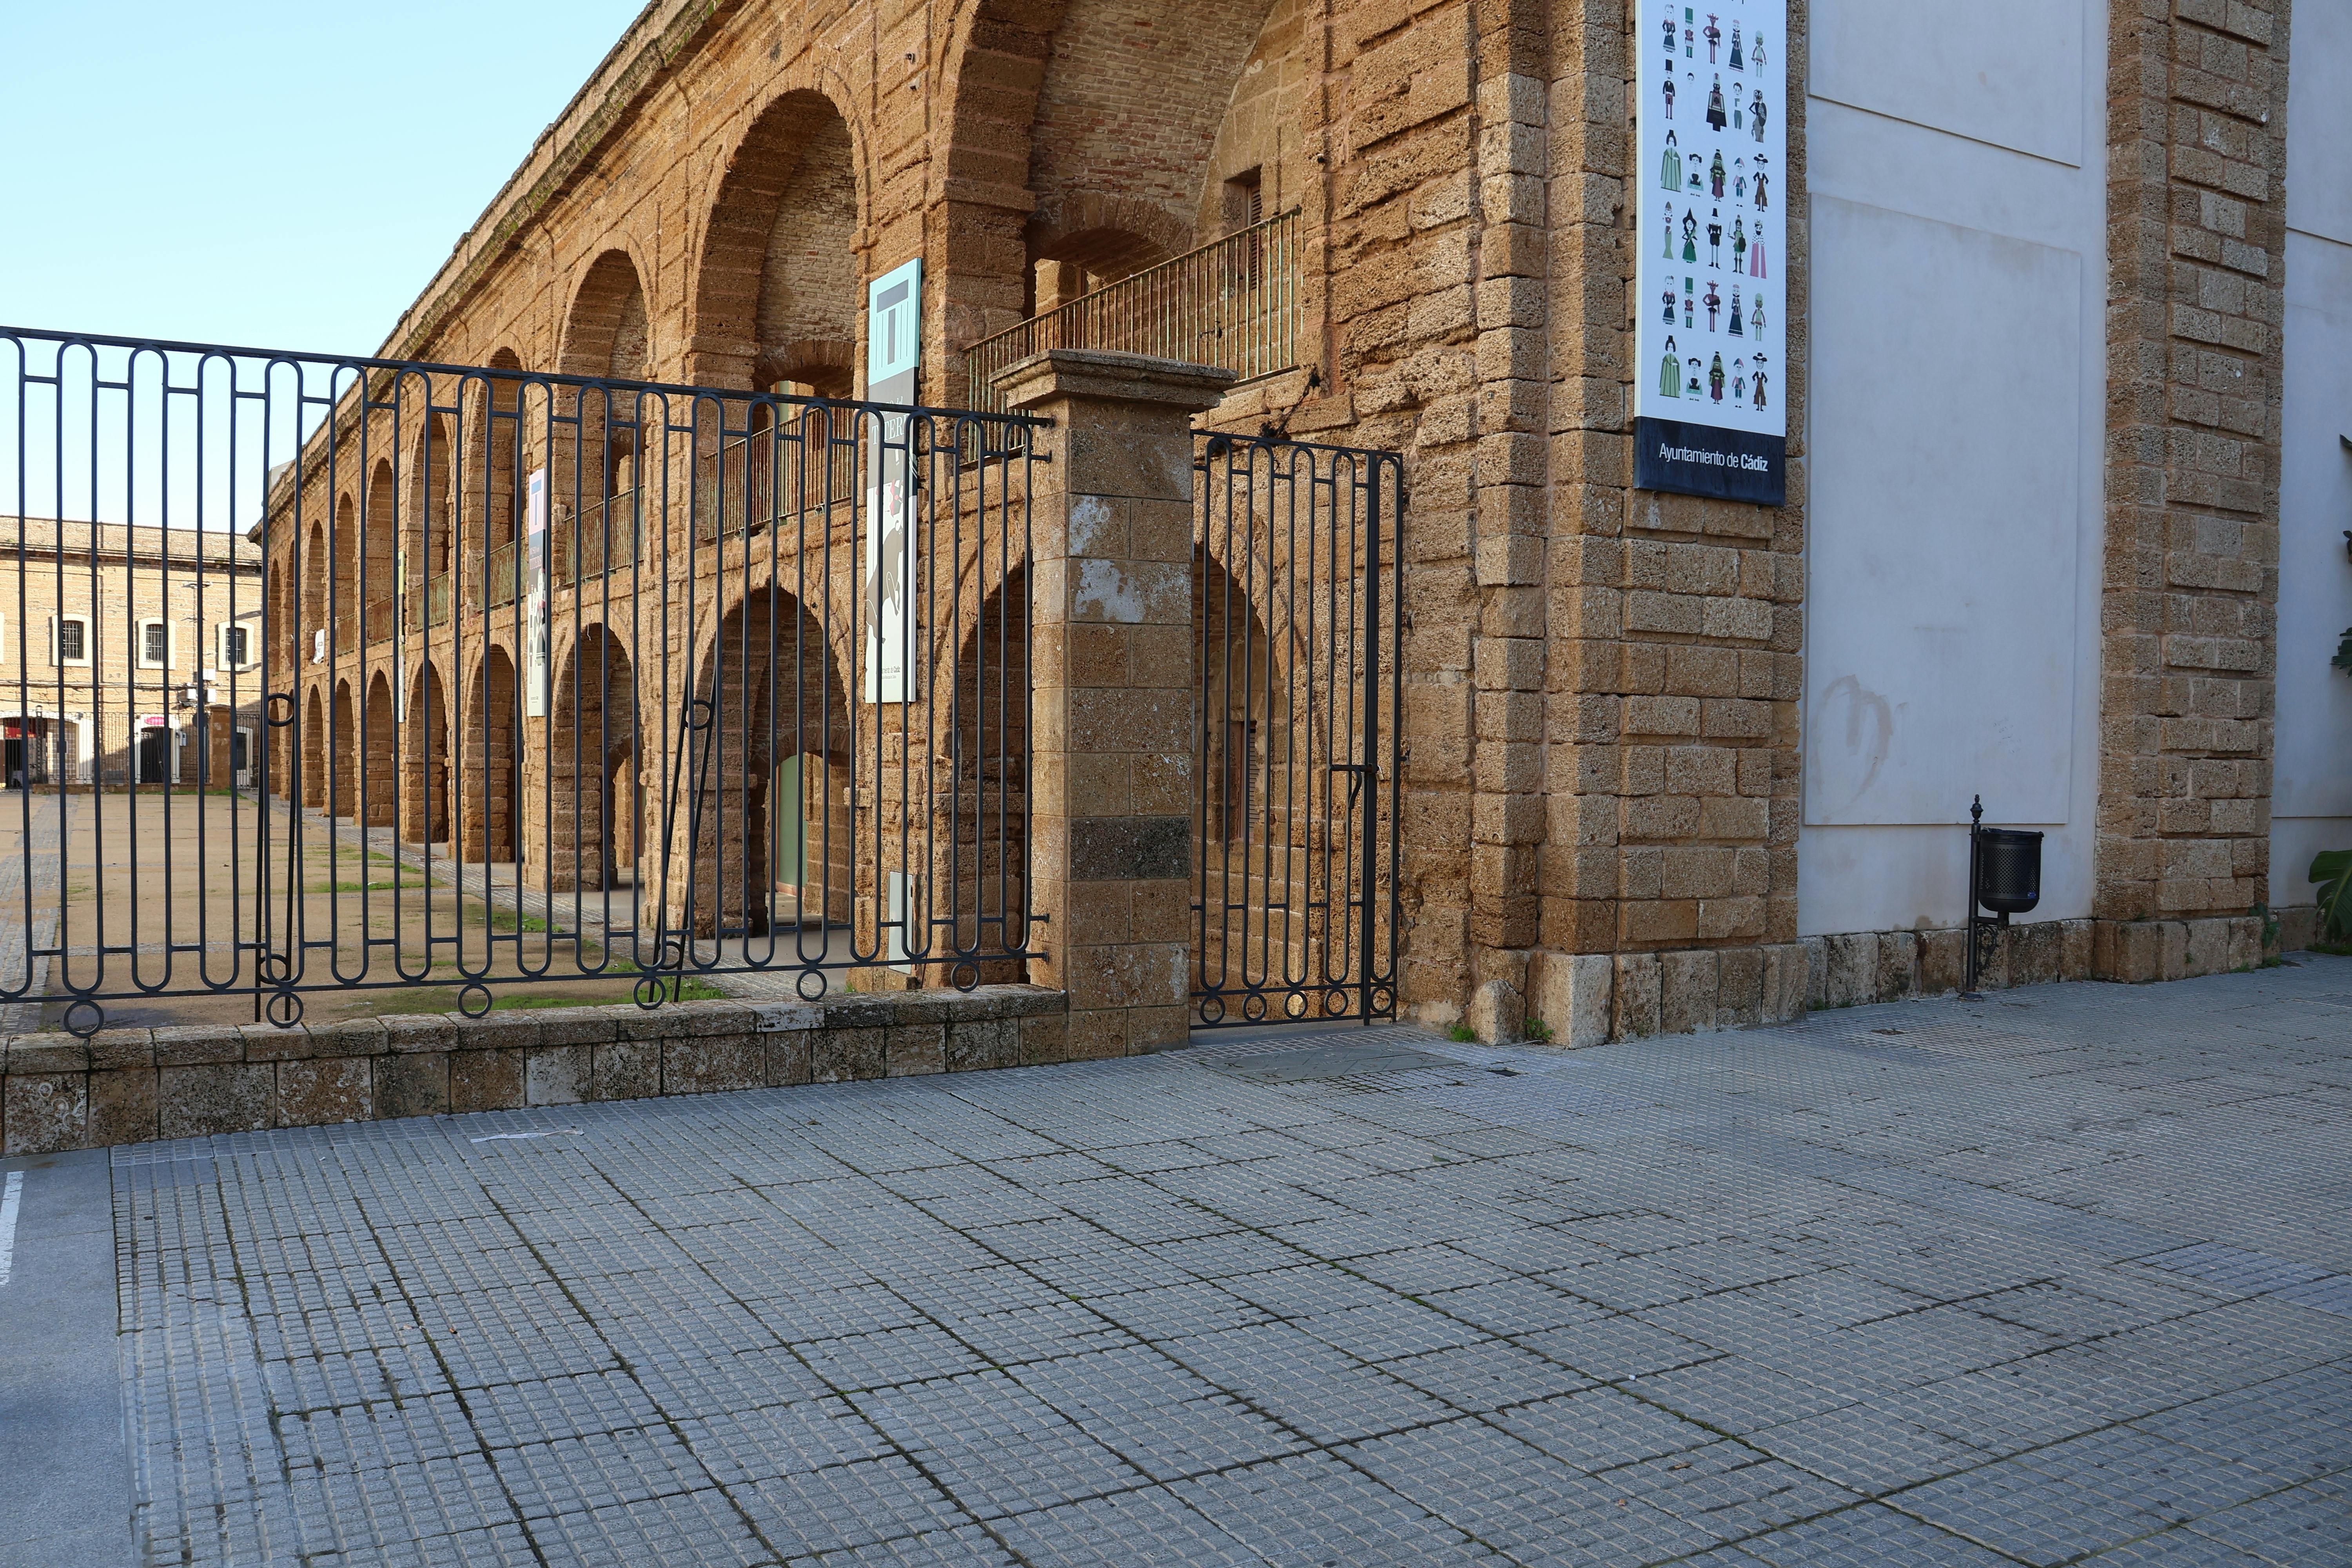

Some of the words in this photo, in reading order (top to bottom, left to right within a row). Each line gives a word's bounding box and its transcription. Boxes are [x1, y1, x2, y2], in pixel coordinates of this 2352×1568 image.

[871, 413, 911, 445] TTER
[1659, 443, 1725, 466] Ayuntamiento
[1727, 452, 1739, 468] de
[1740, 454, 1768, 472] Cádiz
